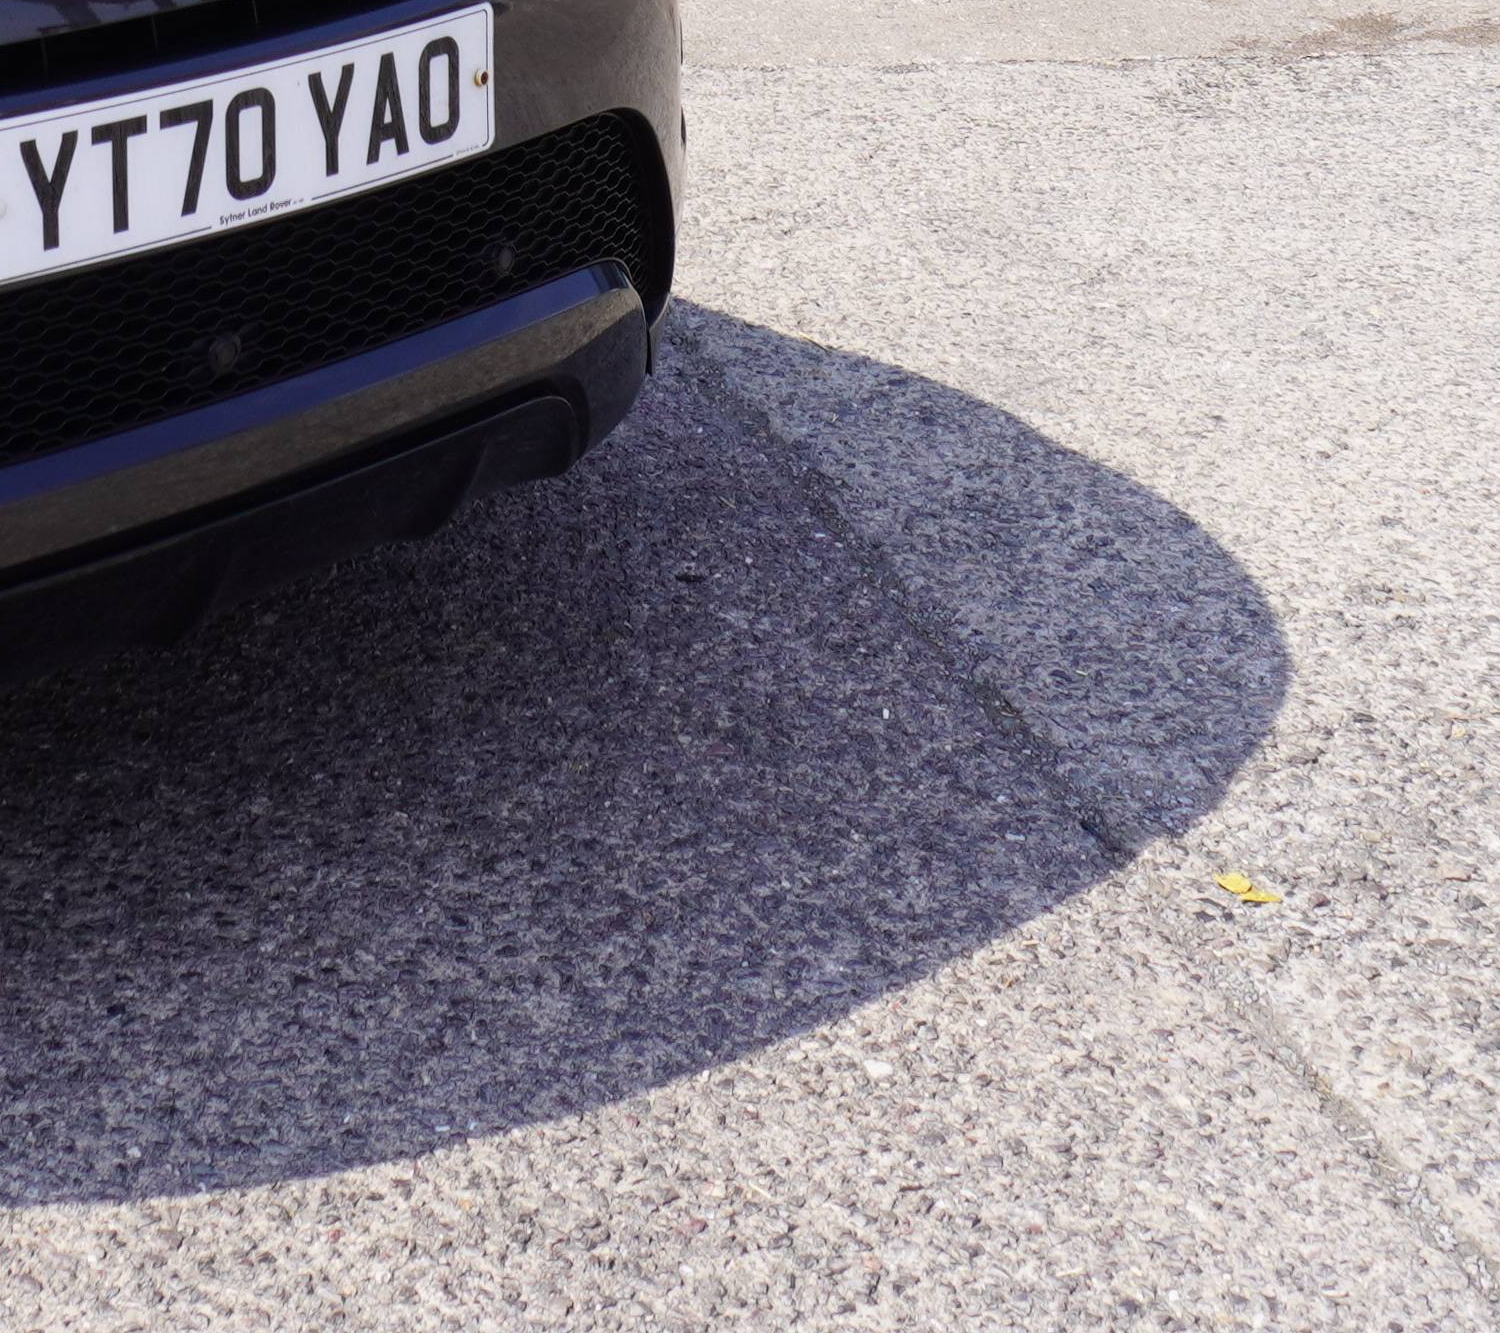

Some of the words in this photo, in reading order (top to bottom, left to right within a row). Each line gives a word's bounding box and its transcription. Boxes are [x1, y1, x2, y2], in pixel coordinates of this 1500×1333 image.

[19, 86, 276, 251] YT70
[307, 35, 460, 177] YAO
[247, 203, 268, 218] Land
[269, 198, 292, 212] Rover
